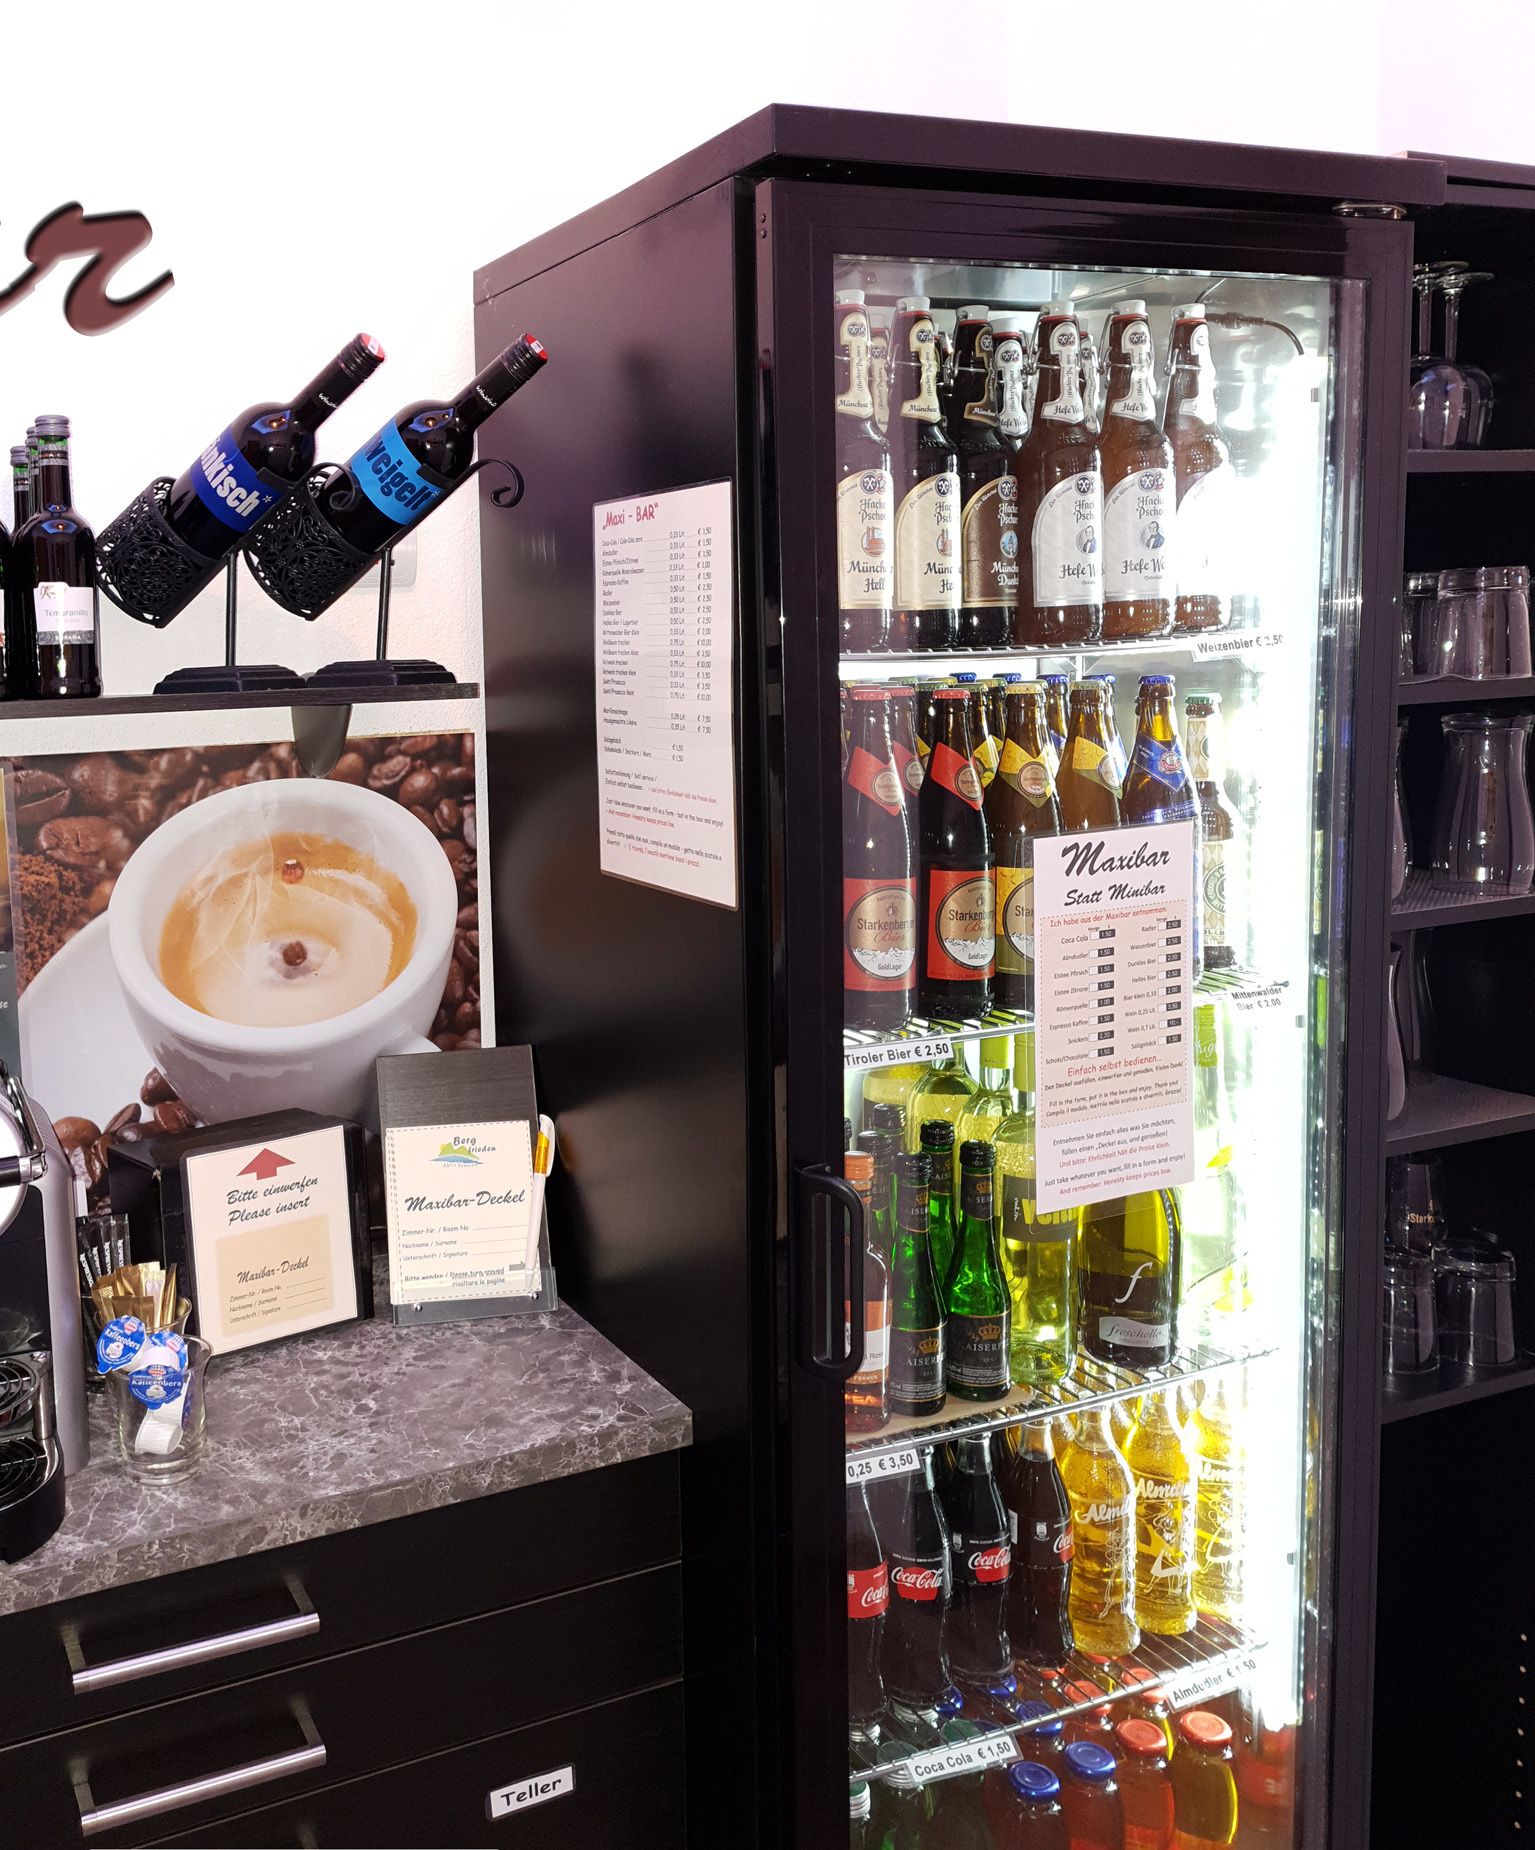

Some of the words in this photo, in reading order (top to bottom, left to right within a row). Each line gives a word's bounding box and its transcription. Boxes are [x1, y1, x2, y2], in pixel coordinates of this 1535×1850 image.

[200, 437, 261, 517] nkisch
[1197, 639, 1253, 654] Weizenbier
[1061, 841, 1171, 877] Maxibar
[1064, 887, 1103, 907] Statt
[1108, 880, 1166, 901] Minibar
[1050, 919, 1062, 928] Ich
[1064, 916, 1080, 926] habe
[1081, 916, 1092, 924] aus
[1093, 914, 1104, 923] der
[1106, 911, 1132, 922] Maxibar
[1061, 935, 1075, 945] Coca
[1076, 933, 1089, 942] Cola
[1231, 987, 1282, 1000] Mittenwalder
[1068, 1036, 1089, 1046] Snickers
[844, 1052, 884, 1067] Tiroler
[887, 1048, 912, 1061] Bier
[915, 1045, 923, 1057] €
[925, 1043, 949, 1058] 2,50
[1068, 1064, 1097, 1078] Einfach
[1098, 1059, 1122, 1072] selbst
[1056, 1080, 1073, 1089] Deckel
[453, 1136, 477, 1147] Berg
[1053, 1134, 1085, 1146] Entnehmen
[1095, 1129, 1115, 1138] einfach
[1116, 1126, 1128, 1134] alles
[1061, 1147, 1077, 1156] füllen
[1129, 1135, 1140, 1143] und
[468, 1145, 497, 1156] frieden
[1060, 1159, 1071, 1168] Und
[1088, 1151, 1116, 1163] Ehrlichkeit
[1117, 1149, 1128, 1157] hält
[1138, 1144, 1155, 1152] Preise
[1044, 1179, 1056, 1187] Just
[1057, 1175, 1069, 1183] take
[1070, 1171, 1096, 1181] whatever
[1143, 1158, 1157, 1167] form
[1157, 1156, 1168, 1164] and
[1060, 1187, 1071, 1195] And
[1103, 1176, 1125, 1186] Honesty
[1126, 1173, 1142, 1182] keeps
[1143, 1170, 1160, 1179] prices
[226, 1189, 259, 1206] Bitte
[263, 1175, 320, 1198] einwerfen
[405, 1188, 526, 1212] Maxibar-Deckel
[228, 1208, 272, 1227] Please
[276, 1195, 311, 1214] insert
[443, 1225, 459, 1233] Room
[435, 1239, 458, 1247] Surname
[403, 1253, 438, 1262] Unterschrift
[443, 1250, 469, 1259] Signature
[237, 1255, 311, 1285] Maxibar-Deckel
[848, 1462, 873, 1479] 0,25
[878, 1458, 887, 1471] €
[889, 1453, 913, 1470] 3,50
[891, 1565, 944, 1590] Coca-Cola
[1173, 1674, 1223, 1703] Almdudler
[914, 1761, 946, 1777] Coca
[947, 1753, 973, 1768] Cola
[977, 1747, 987, 1759] €
[988, 1741, 1011, 1758] 1,50
[500, 1778, 562, 1807] Teller
